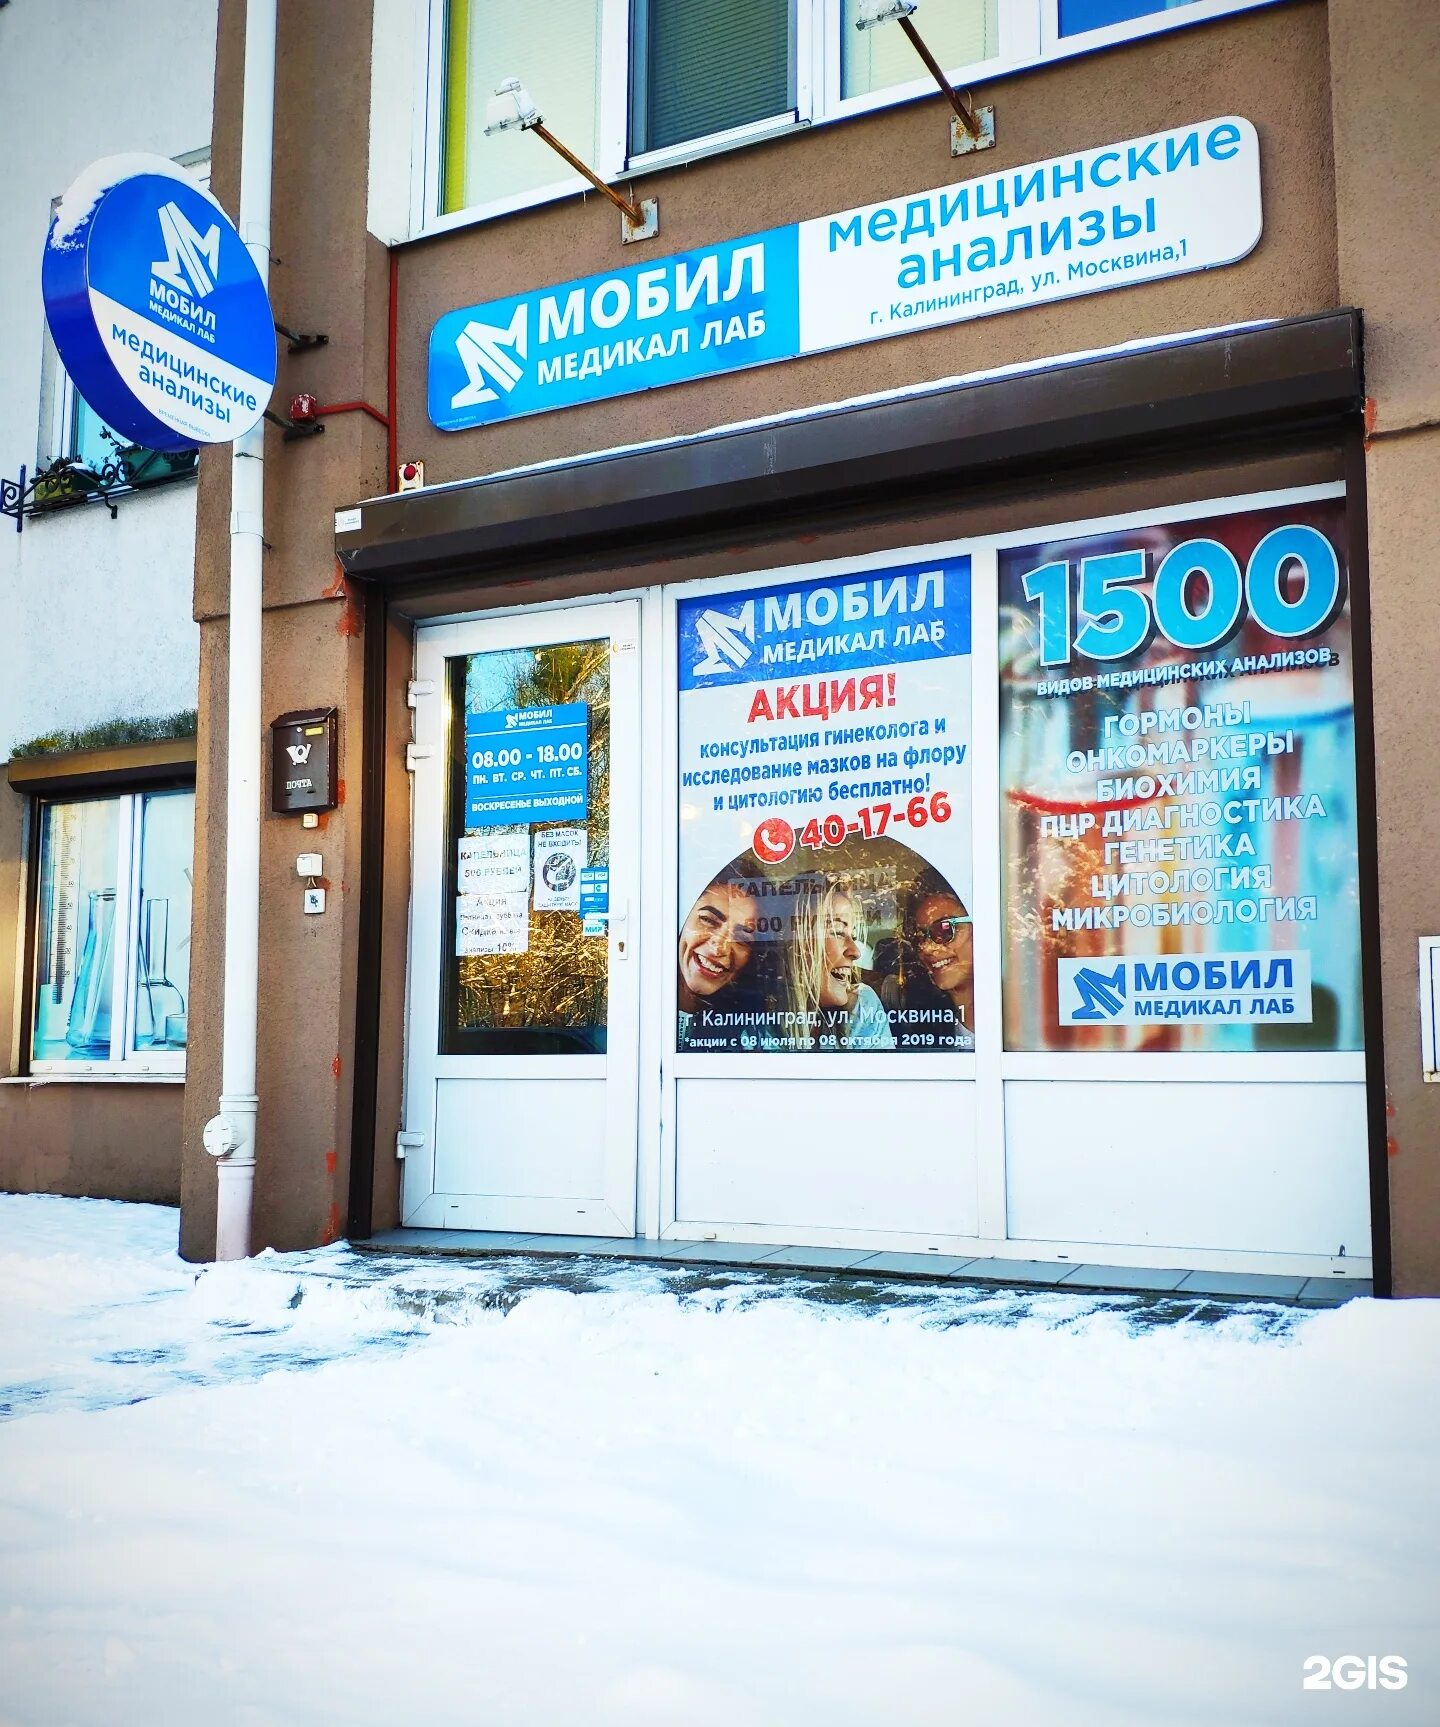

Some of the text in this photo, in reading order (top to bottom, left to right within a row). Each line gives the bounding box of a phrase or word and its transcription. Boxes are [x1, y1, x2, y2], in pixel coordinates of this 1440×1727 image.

[829, 124, 1241, 252] медицинские
[897, 198, 1156, 289] анализы
[539, 243, 764, 344] МОБИЛ
[870, 239, 1188, 324] г. Калининград, ул. Москвина,1
[150, 278, 216, 330] МОБИЛ
[150, 300, 215, 343] МЕДИКАЛ ЛАБ
[113, 323, 257, 411] медицинские
[538, 310, 765, 385] МЕДИКАЛ ЛАБ
[139, 367, 230, 423] анализы
[764, 570, 944, 632] МОБИЛ
[1021, 524, 1339, 667] 1500
[763, 622, 945, 664] МЕДИКАЛ ЛАБ
[1037, 648, 1331, 696] ВИДОВ МЕДИЦИНСКИХ АНАЛИЗОВ
[519, 709, 552, 720] МОБИЛ
[747, 673, 896, 723] АКЦИЯ!
[700, 718, 946, 758] консультация гинеколога и
[1104, 701, 1251, 738] ГОРМОНЫ
[472, 748, 521, 768] 08.00
[537, 743, 582, 762] 18.00
[683, 744, 967, 787] исследование мазков на флору
[1066, 729, 1293, 773] ОНКОМАРКЕРЫ
[286, 779, 312, 789] ПОЧТА
[473, 766, 582, 784] ПН. ВТ. СР. ЧТ. ПТ. СБ.
[714, 773, 930, 810] и цитологию бесплатно!
[1096, 766, 1262, 802] БИОХИМИЯ
[472, 793, 583, 811] ВОСКРЕСЕНЬЕ ВЫХОДНОЙ
[800, 791, 951, 850] 40-17-66
[1040, 794, 1328, 839] ПЦР ДИАГНОСТИКА
[1104, 833, 1256, 865] ГЕНЕТИКА
[1091, 865, 1271, 901] ЦИТОЛОГИЯ
[1052, 897, 1317, 931] МИКРОБИОЛОГИЯ
[1134, 959, 1293, 992] МОБИЛ
[685, 1005, 965, 1028] г. Калининград, ул. Москвина,1
[1134, 998, 1294, 1018] МЕДИКАЛ ЛАБ
[731, 1038, 737, 1046] с
[741, 1036, 757, 1046] 08
[761, 1037, 795, 1046] июля
[800, 1037, 815, 1047] по
[819, 1035, 836, 1045] 08
[840, 1034, 897, 1048] октября
[902, 1034, 934, 1045] 2019
[939, 1035, 972, 1047] года
